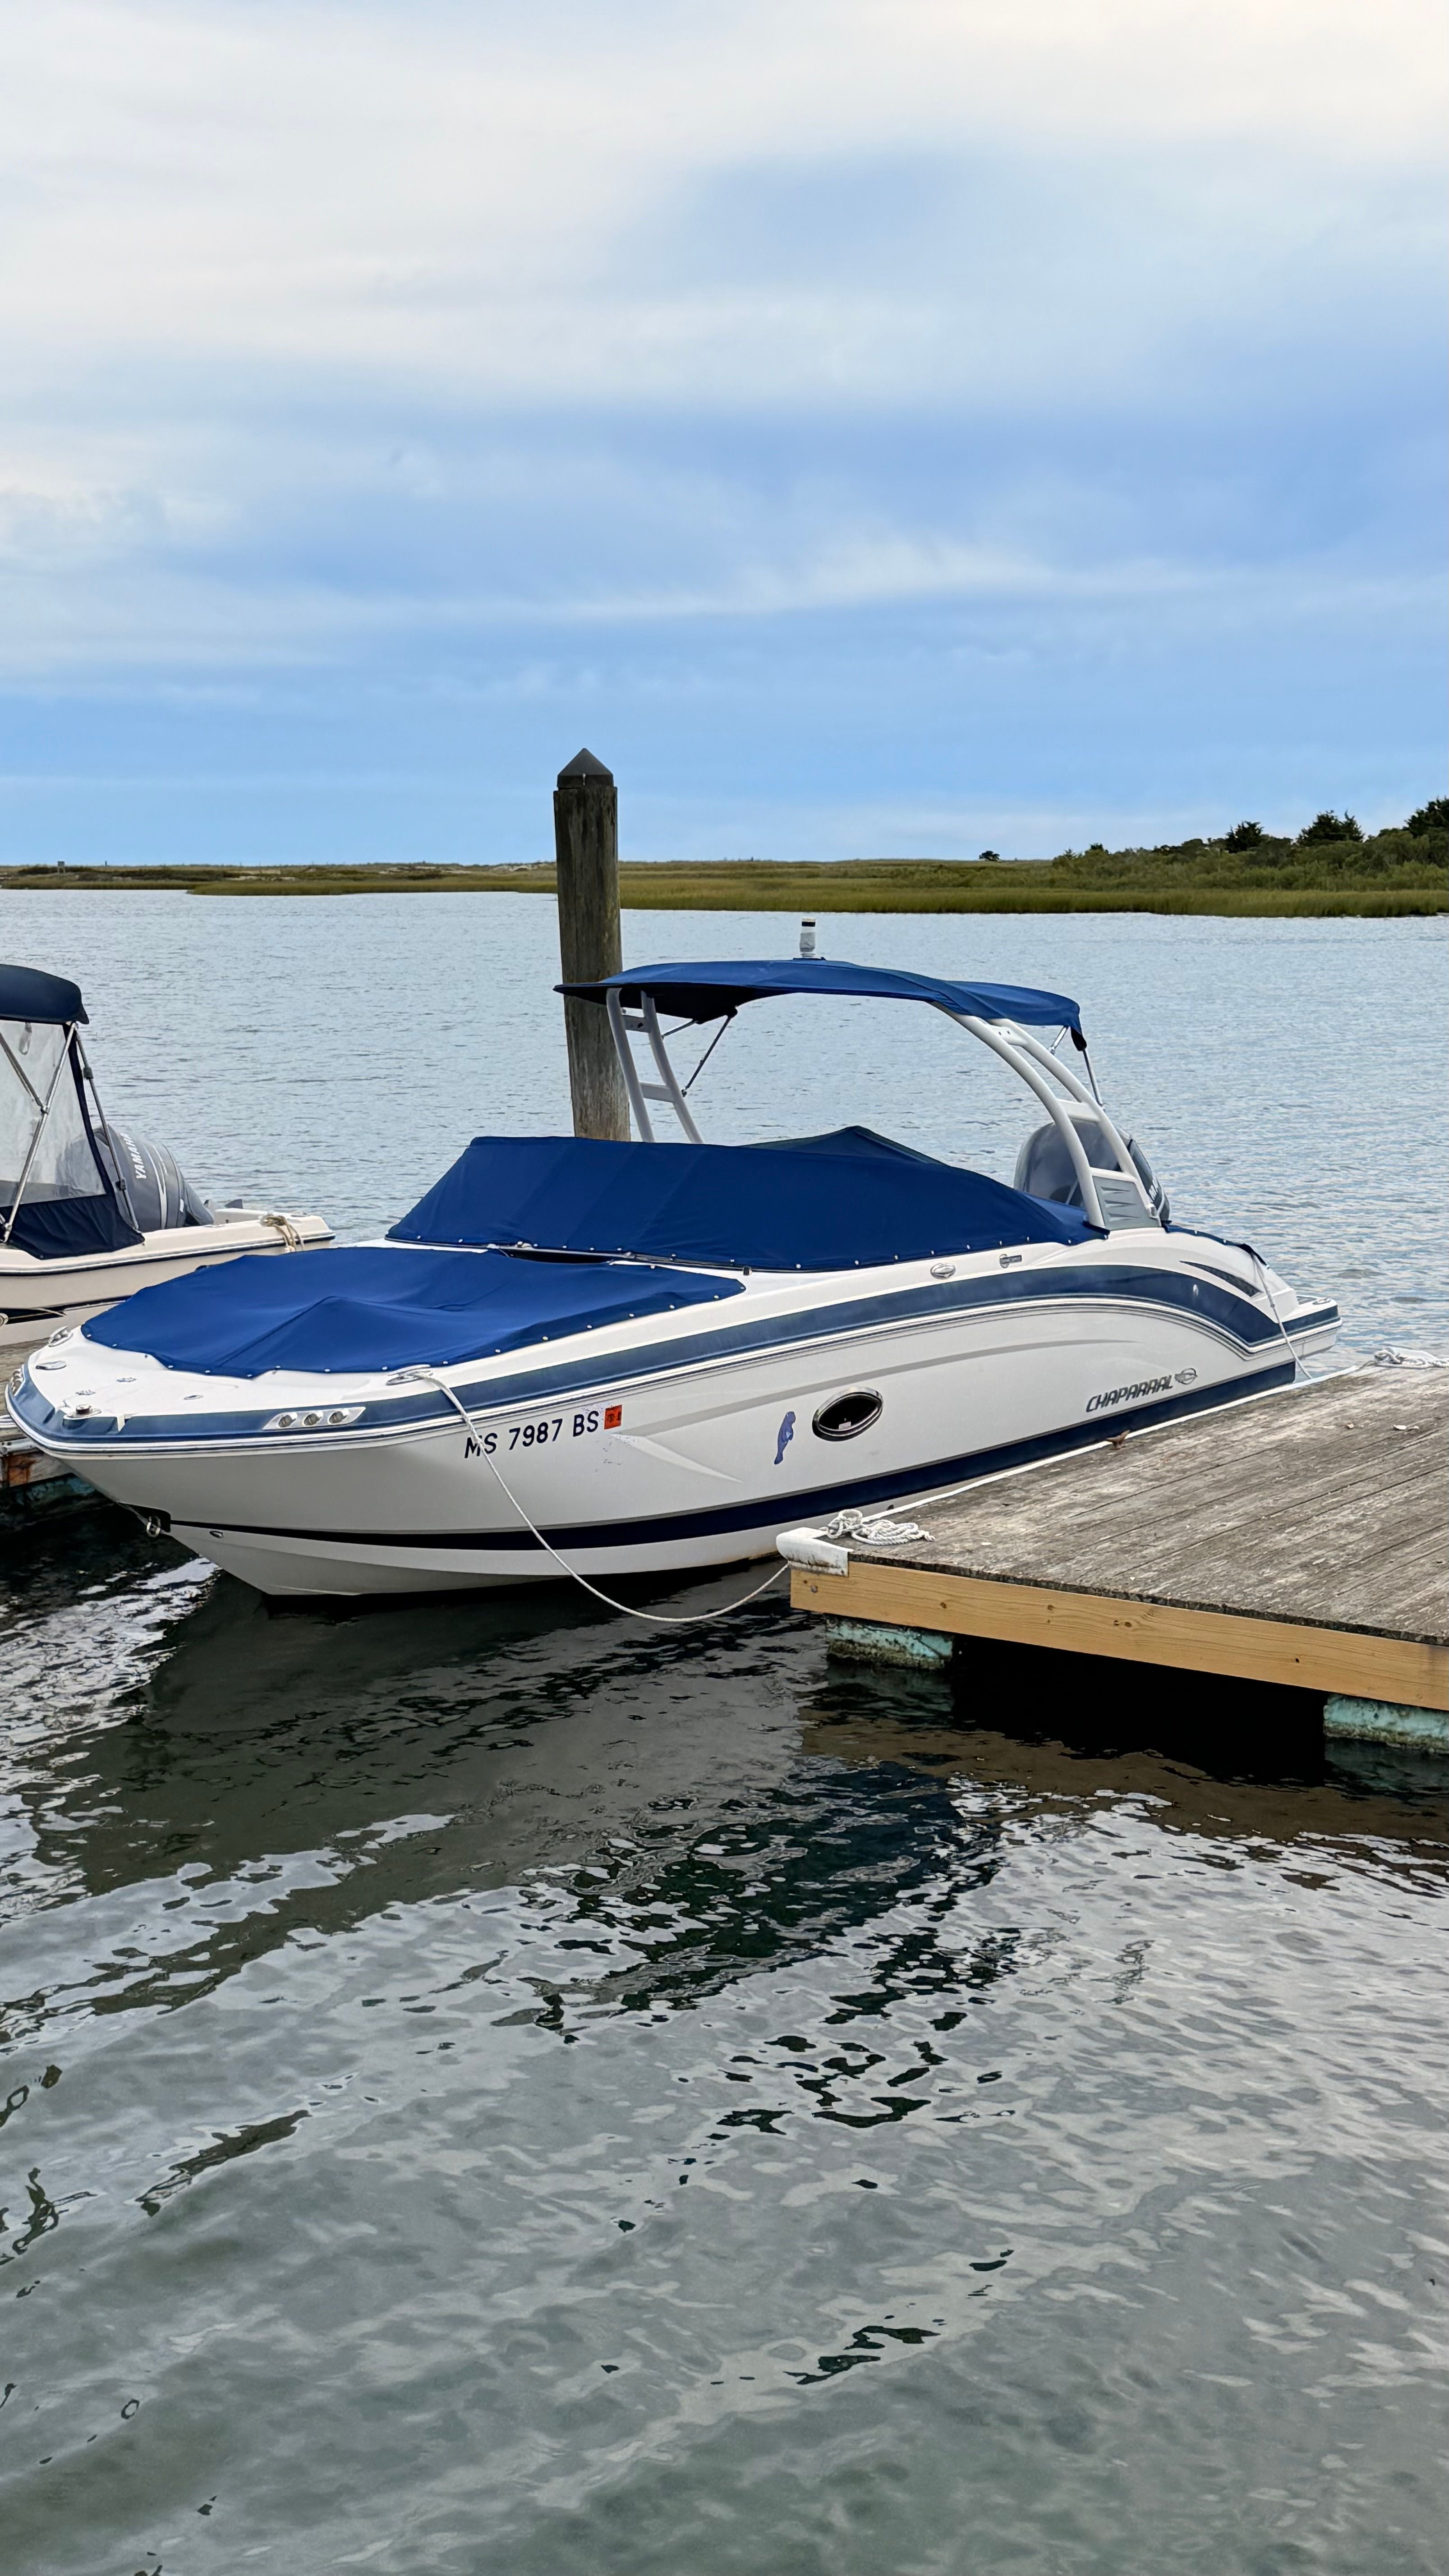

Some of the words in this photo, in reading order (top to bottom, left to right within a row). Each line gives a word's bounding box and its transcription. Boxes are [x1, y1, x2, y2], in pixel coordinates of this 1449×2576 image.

[120, 1133, 147, 1178] YAMAHA
[1086, 1375, 1173, 1412] CHAPARRAL
[464, 1432, 498, 1458] MS
[509, 1418, 563, 1450] 7987
[573, 1410, 599, 1437] BS
